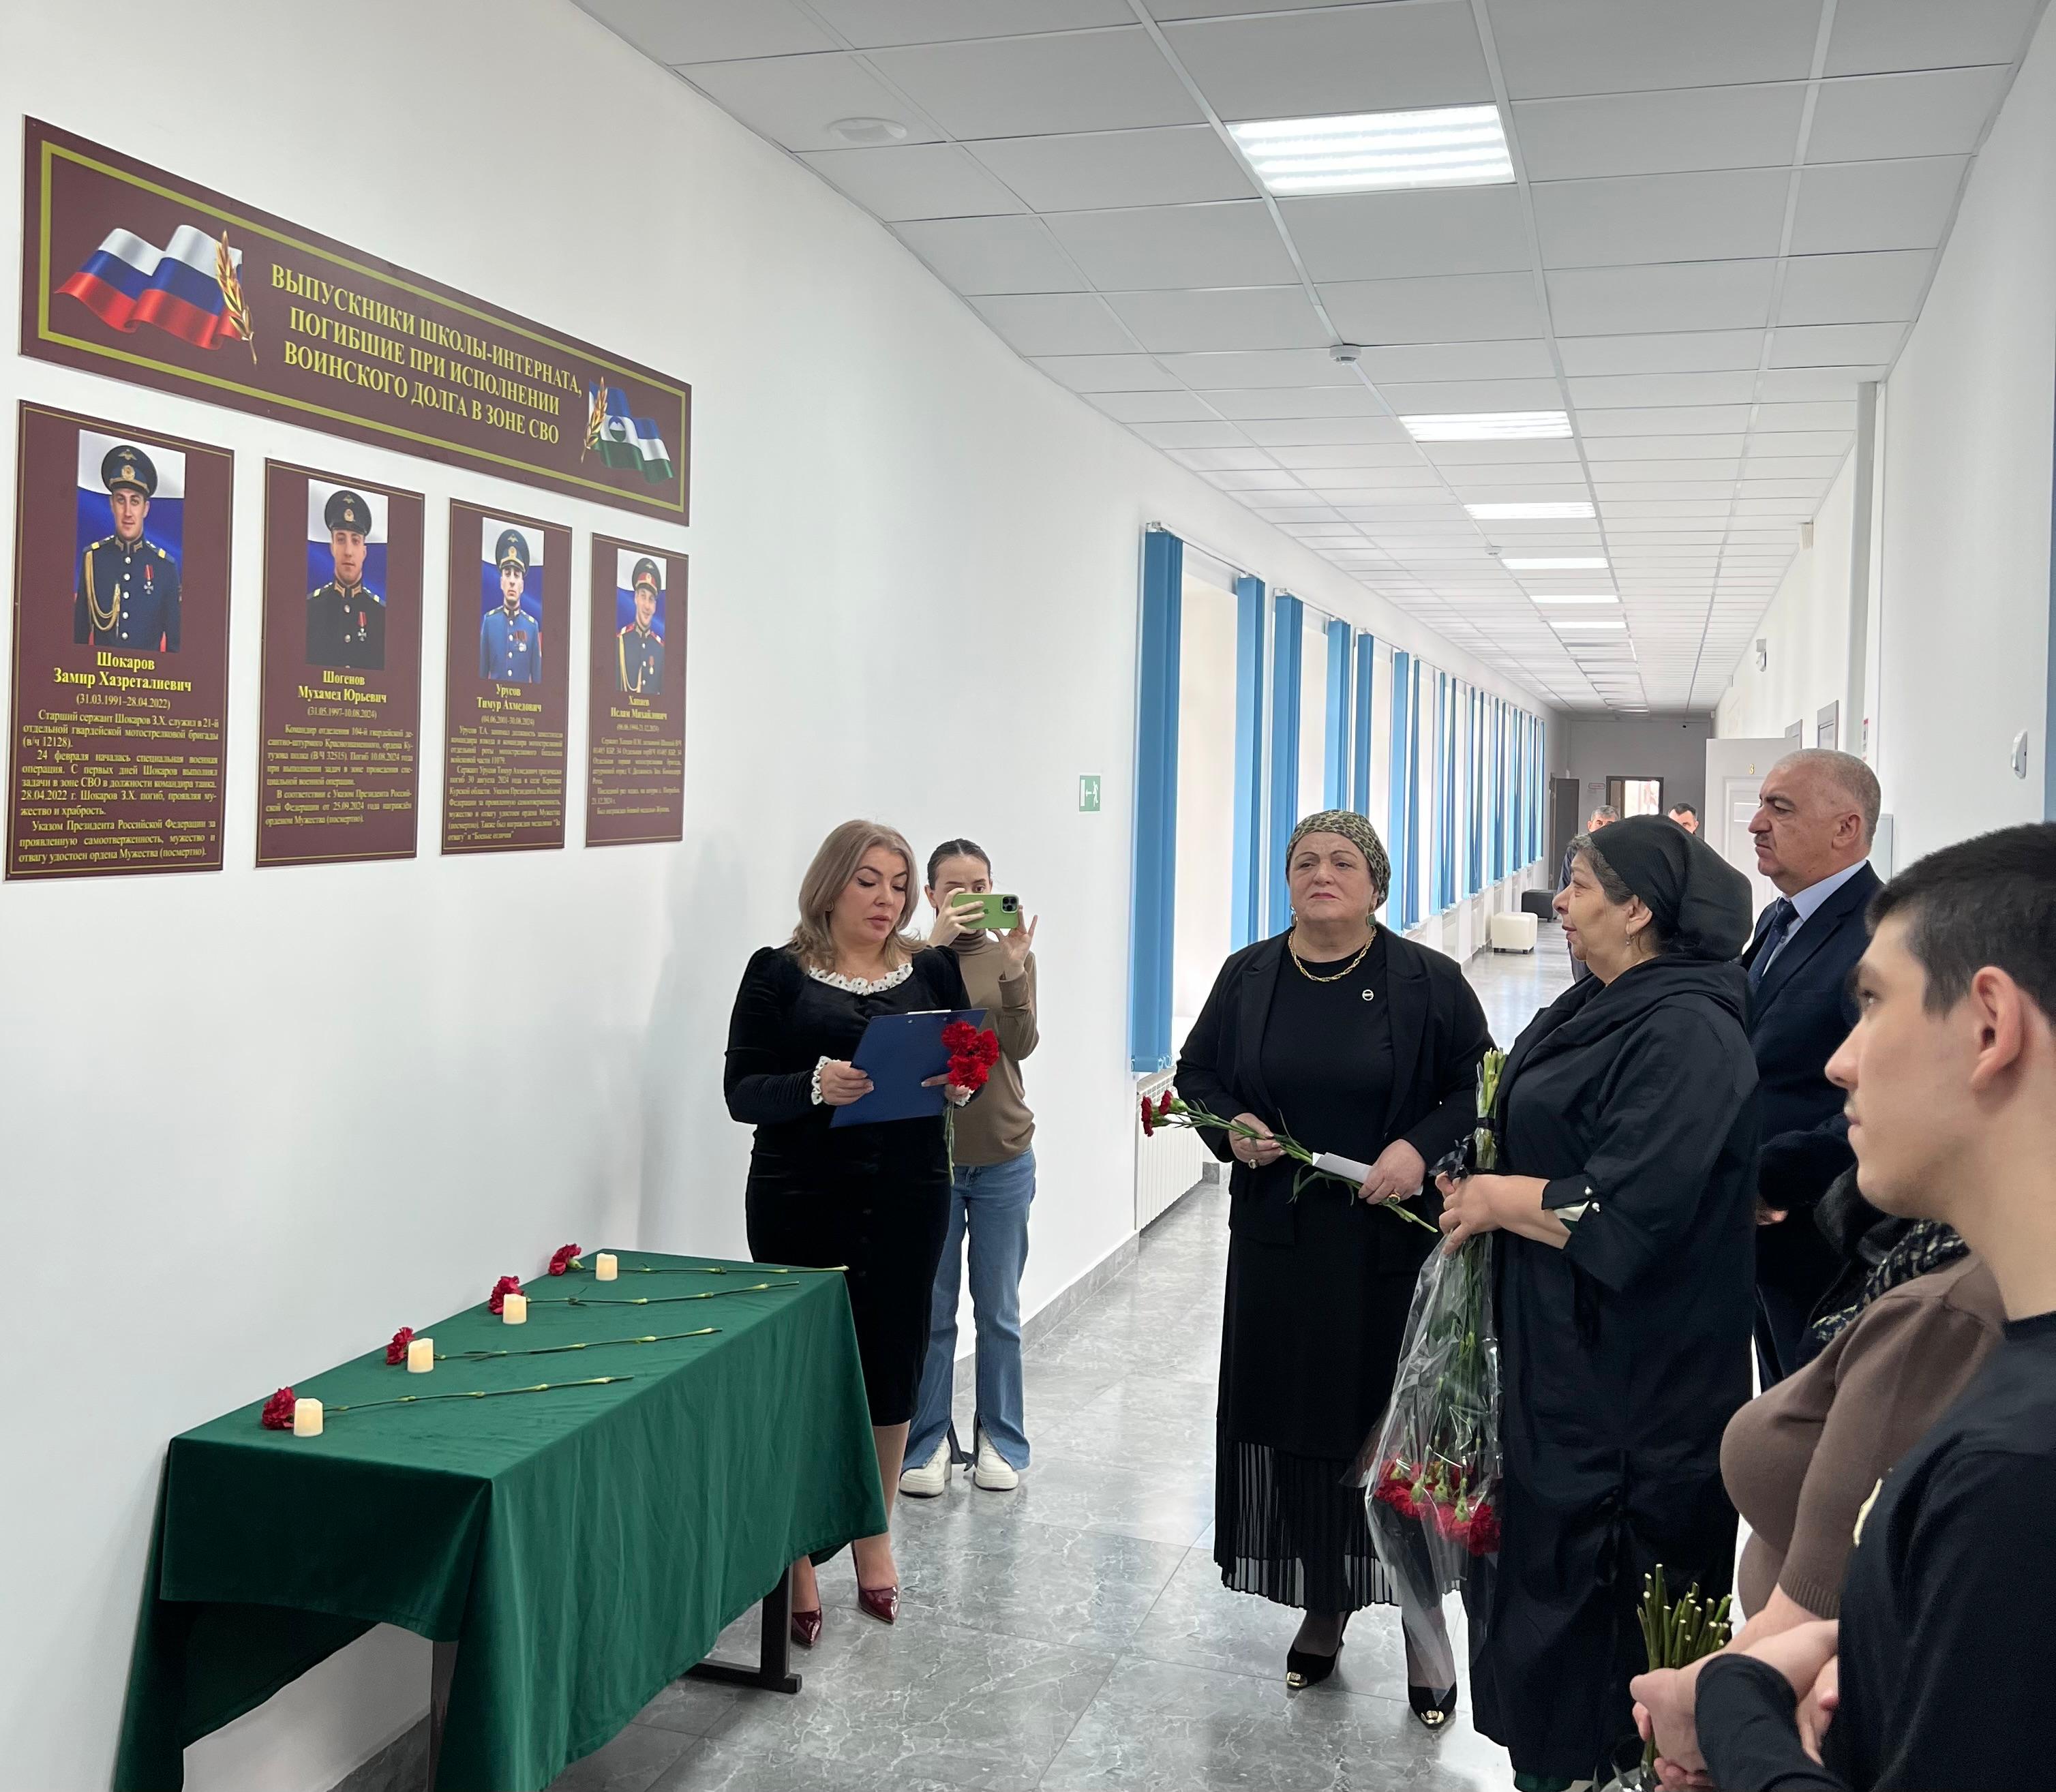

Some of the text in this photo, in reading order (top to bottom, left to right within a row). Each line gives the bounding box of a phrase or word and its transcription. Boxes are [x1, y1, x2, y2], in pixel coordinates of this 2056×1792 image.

[272, 264, 581, 397] ВЫПУСКНИКИ ШКОЛЫ-ИНТЕРНАТА,
[290, 307, 559, 415] ПОГИБШИЕ ПРИ ИСПОЛНЕНИИ
[284, 341, 558, 444] ВОИНСКОГО ДОЛГА В ЗОНЕ СВО
[97, 652, 155, 672] Шокаров
[55, 667, 191, 691] Замир Хазреталиевич
[323, 671, 365, 685] Шогенов
[299, 686, 387, 704] Мухамед Юрьевич
[38, 710, 78, 722] Старший
[80, 714, 112, 724] сержант
[115, 714, 151, 727] Шокаров
[22, 725, 68, 733] отдельной
[72, 726, 121, 738] гвардейской
[125, 729, 185, 740] мотострелковой
[43, 736, 73, 749] 12128).
[37, 750, 48, 759] 24
[55, 750, 89, 763] февраля
[22, 766, 65, 775] операция.
[71, 764, 78, 774] С
[84, 767, 113, 776] первых
[119, 765, 138, 774] дней
[143, 765, 177, 778] Шокаров
[1749, 763, 1755, 774] 3
[80, 777, 101, 787] СВО
[21, 790, 67, 800] 28.04.2022
[80, 790, 117, 802] Шокаров
[61, 805, 106, 817] храбрость.
[33, 821, 63, 831] Указом
[67, 820, 115, 833] Президента
[118, 819, 162, 829] Российской
[19, 838, 78, 849] проявленную
[84, 836, 164, 847] самоотверженность,
[170, 835, 205, 845] мужество
[18, 847, 207, 864] отвагу удостоен ордена Мужества (посмертно).
